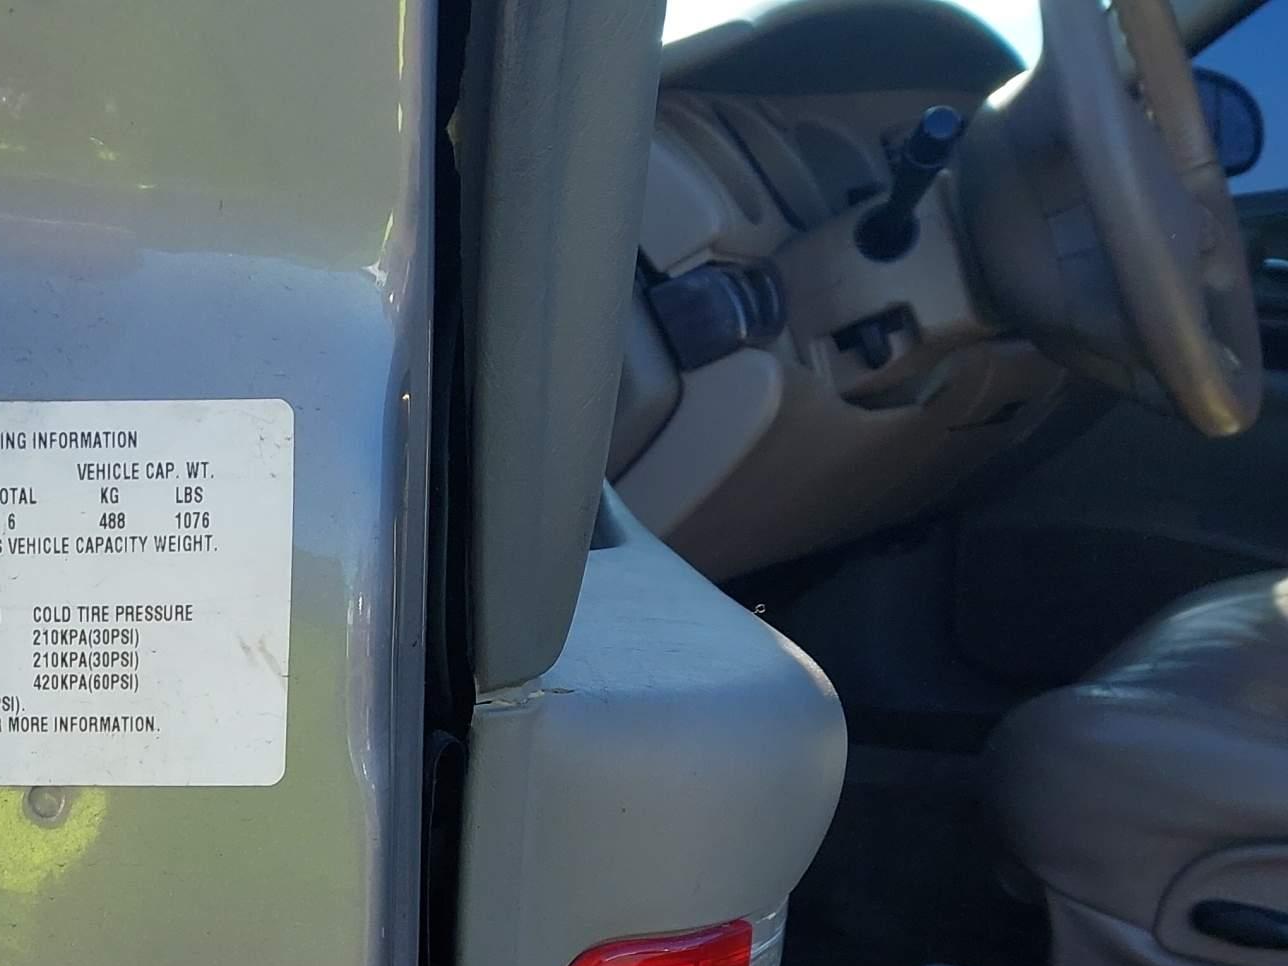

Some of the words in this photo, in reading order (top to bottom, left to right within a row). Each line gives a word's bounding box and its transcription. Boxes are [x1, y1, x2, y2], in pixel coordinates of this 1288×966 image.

[33, 431, 137, 449] INFORMATION
[77, 463, 139, 480] VEHICLE
[146, 462, 179, 479] CAP.
[186, 462, 213, 479] WT.
[101, 487, 118, 504] KG
[176, 486, 203, 503] LBS
[8, 513, 15, 530] 6
[99, 512, 125, 529] 488
[175, 512, 209, 529] 1076
[8, 537, 69, 554] VEHICLE
[76, 536, 148, 553] CAPACITY
[154, 535, 217, 552] WEIGHT.
[34, 606, 70, 623] COLD
[77, 606, 109, 622] TIRE
[116, 605, 192, 622] PRESSURE
[33, 628, 139, 648] 210KPA(30PSI)
[33, 651, 138, 671] 210KPA(30PSI)
[33, 673, 138, 693] 420KPA(60PSI)
[9, 717, 48, 732] MORE
[54, 716, 160, 732] INFORMATION.
